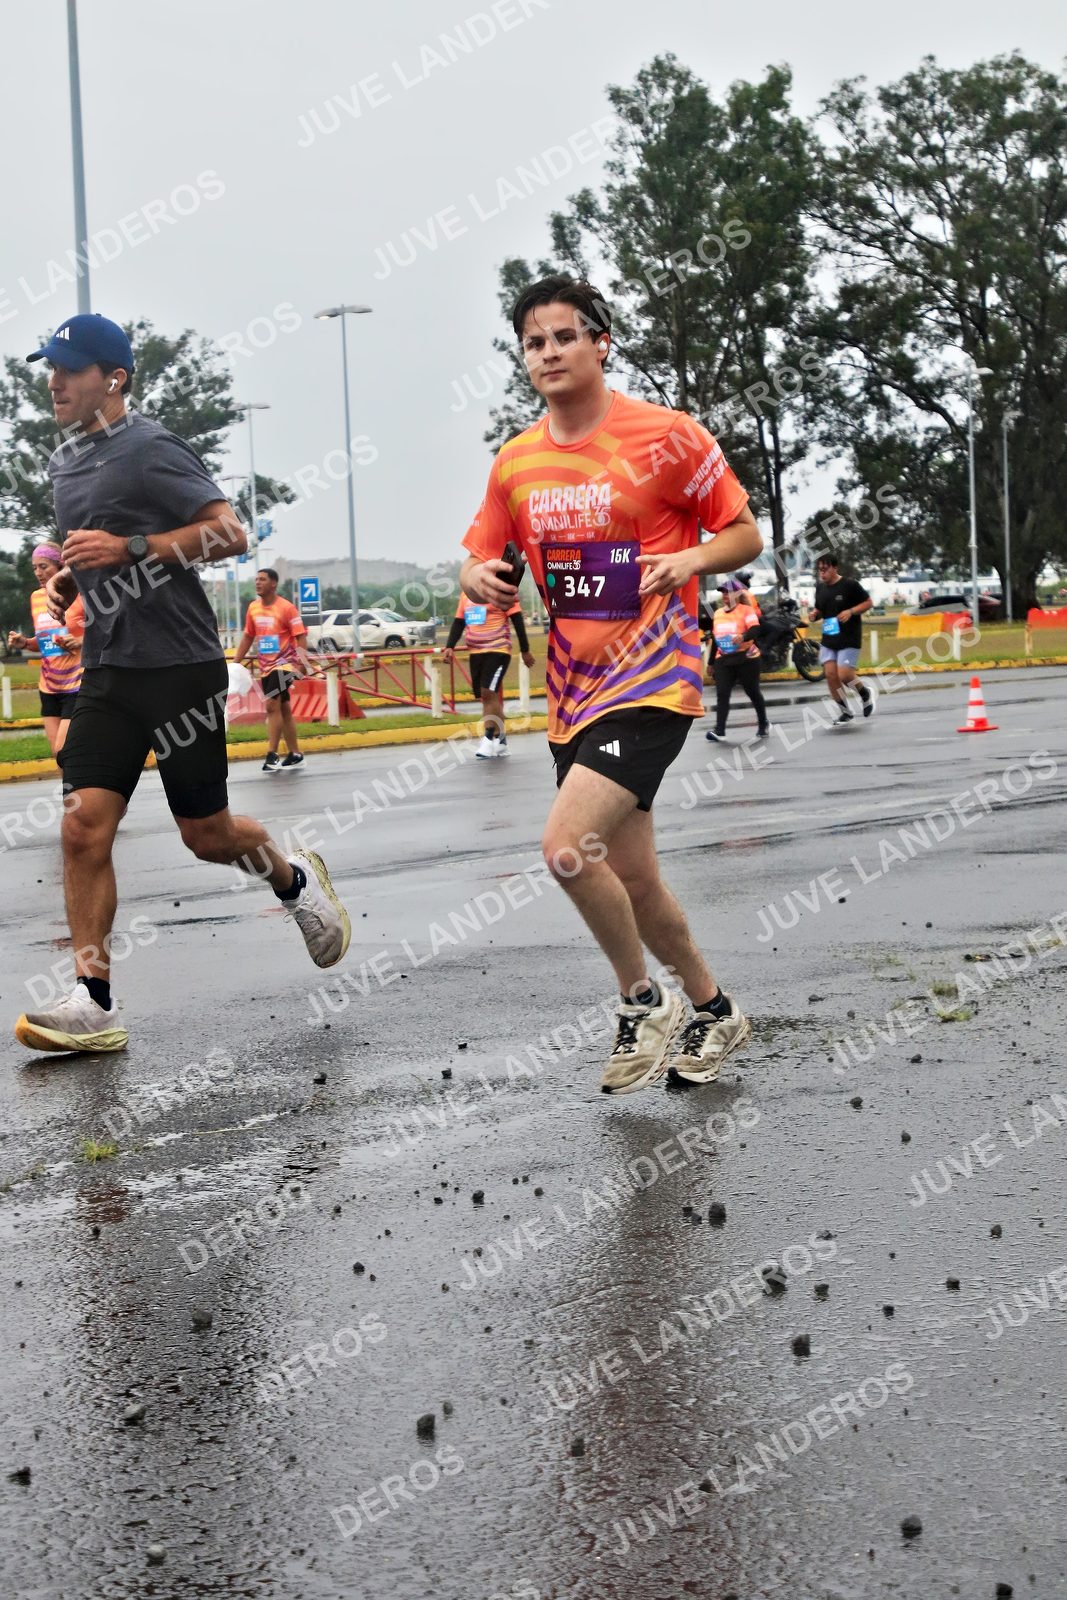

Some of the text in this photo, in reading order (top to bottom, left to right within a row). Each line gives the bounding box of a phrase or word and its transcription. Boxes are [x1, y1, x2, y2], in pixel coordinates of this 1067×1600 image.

[529, 483, 612, 515] CARRERA
[531, 511, 592, 533] OMNILIFE
[546, 548, 582, 562] CARRERA
[610, 548, 632, 564] 15K
[547, 561, 572, 570] OMNILIFE
[564, 575, 606, 598] 347
